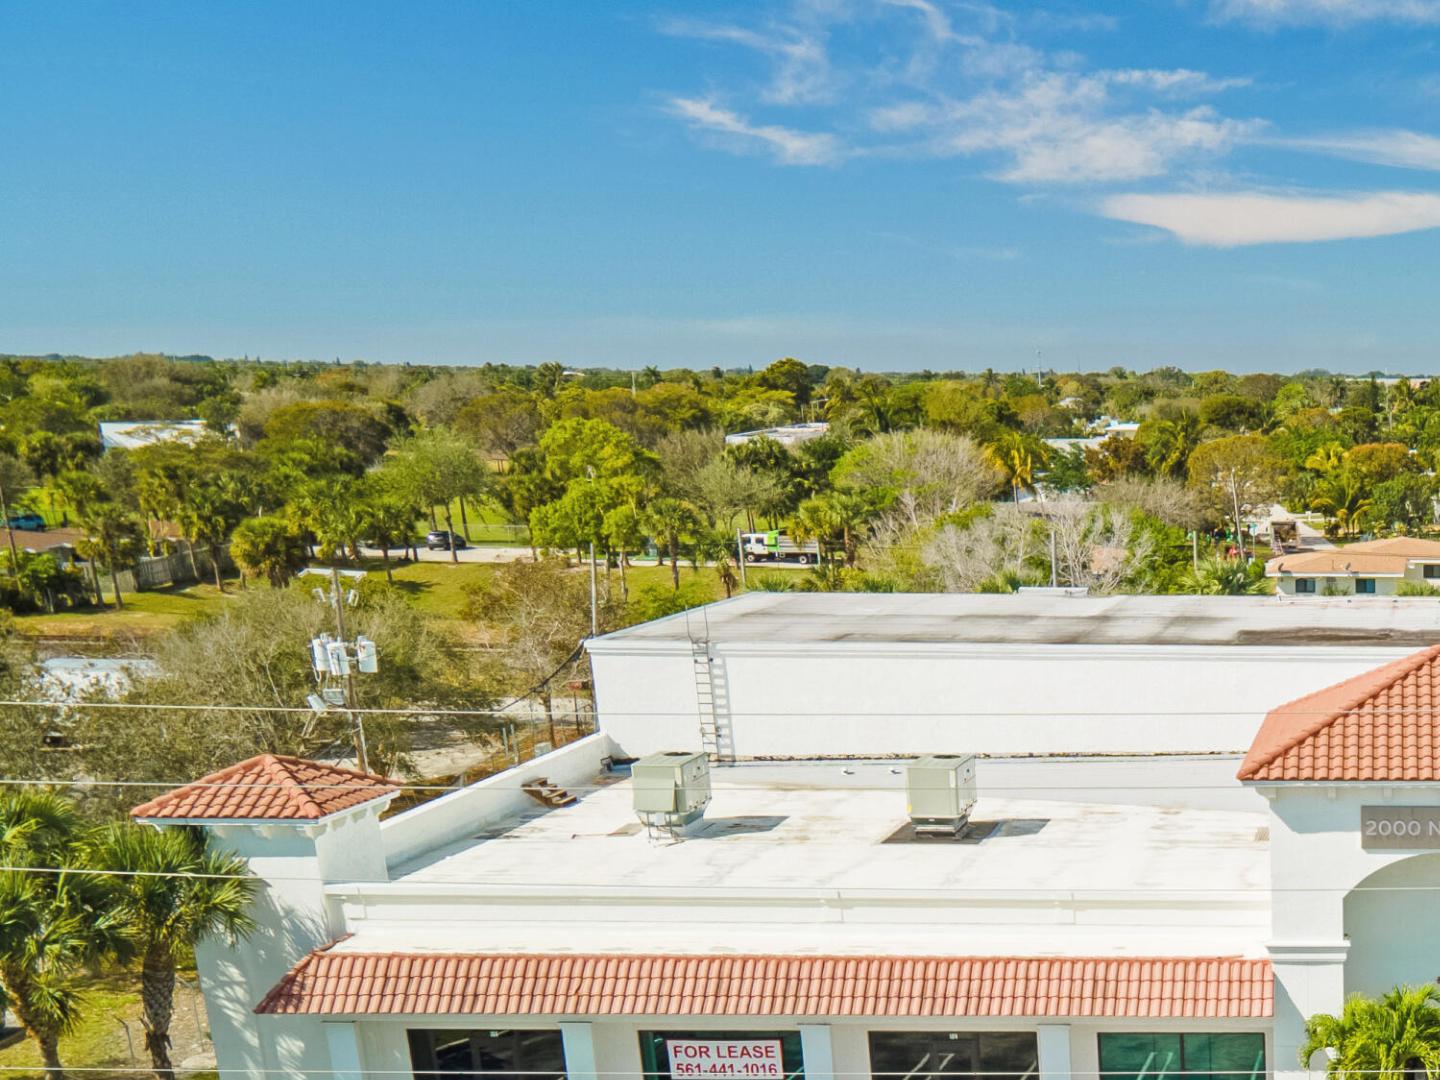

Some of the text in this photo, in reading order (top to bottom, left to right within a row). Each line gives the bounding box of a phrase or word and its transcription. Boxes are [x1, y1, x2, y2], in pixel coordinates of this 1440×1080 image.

[1365, 820, 1421, 836] 2000
[672, 1045, 776, 1059] FOR LEASE
[676, 1063, 778, 1077] 561-441-1016
